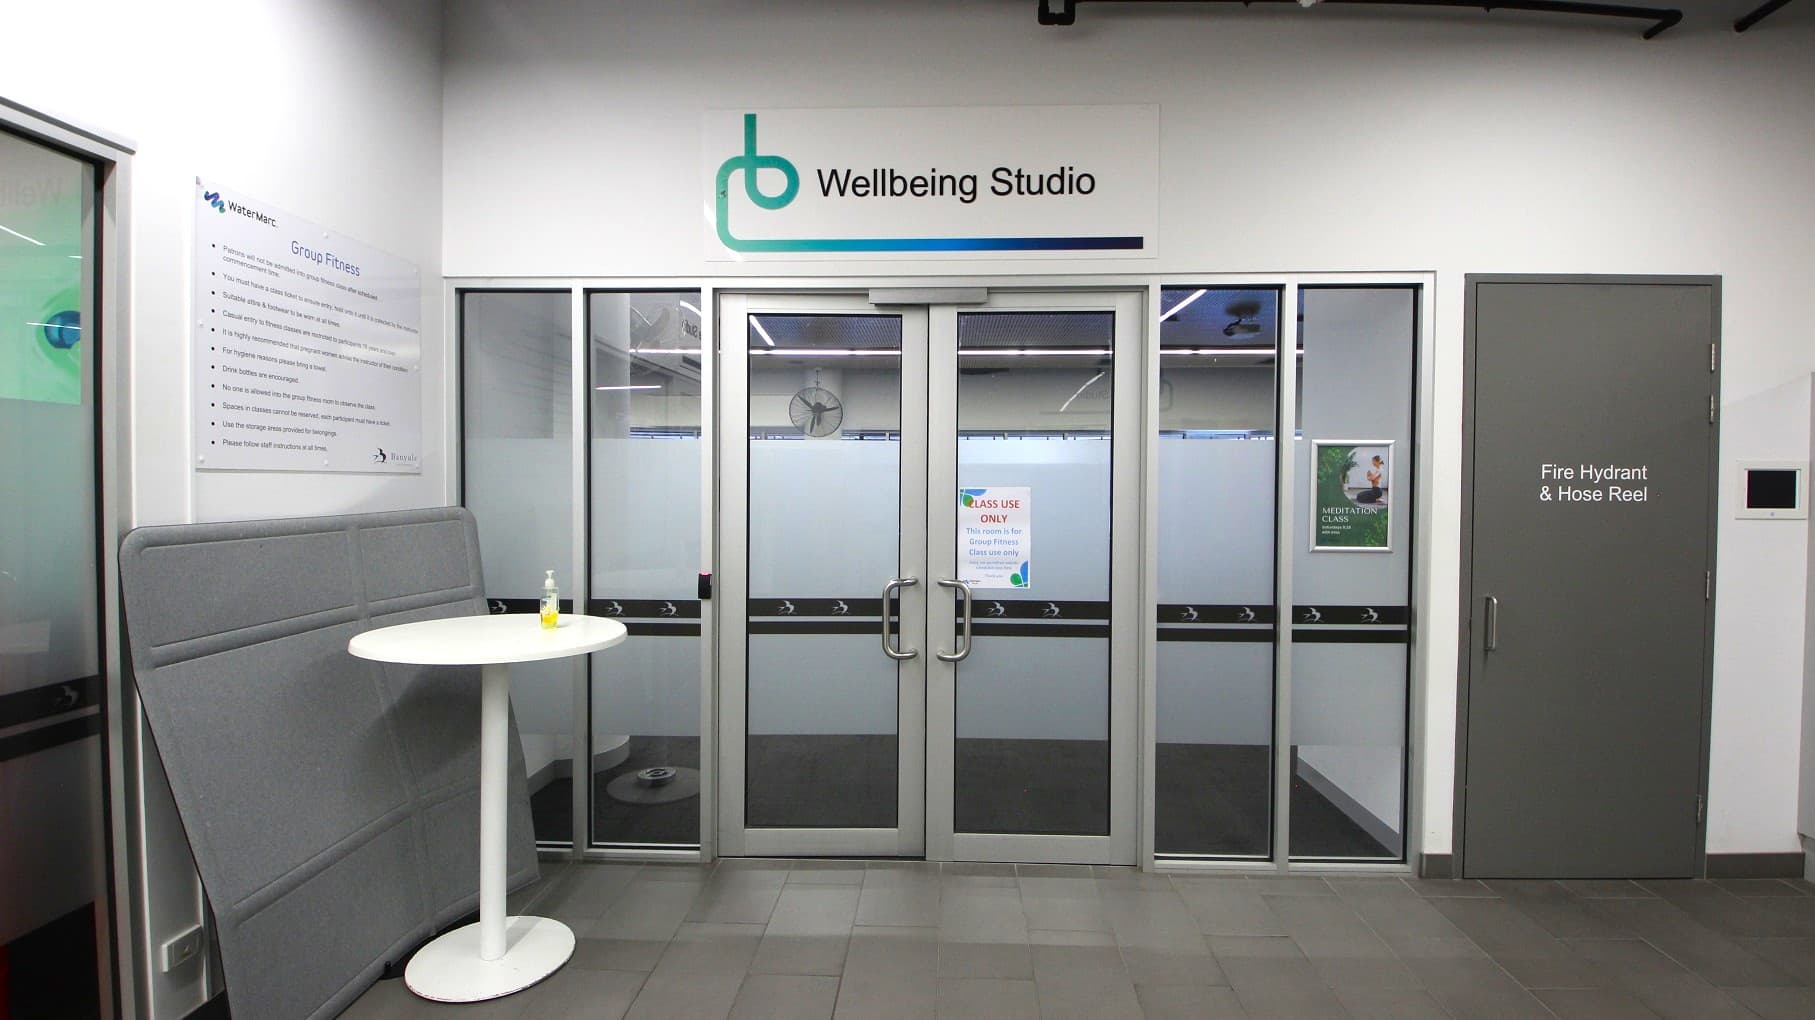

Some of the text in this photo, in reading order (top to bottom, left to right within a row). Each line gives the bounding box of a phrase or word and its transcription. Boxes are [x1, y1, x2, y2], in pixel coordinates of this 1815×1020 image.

[817, 166, 1096, 204] Wellbeing Studio
[228, 200, 276, 228] WaterMarc
[222, 256, 267, 274] commencement
[224, 245, 245, 257] Patrons
[274, 263, 296, 274] admitted
[306, 273, 320, 283] group
[320, 276, 335, 287] fitness
[291, 241, 360, 277] Group Fitness
[222, 273, 235, 282] You
[235, 277, 250, 287] must
[250, 280, 265, 291] have
[269, 287, 284, 296] class
[284, 291, 298, 300] ticket
[222, 291, 246, 304] Suitable
[247, 299, 261, 308] attire
[267, 303, 290, 314] footwear
[222, 309, 243, 321] Casual
[243, 316, 258, 325] entry
[265, 320, 283, 331] fitness
[283, 325, 302, 335] classes
[222, 328, 227, 336] It
[234, 331, 251, 342] highly
[251, 335, 289, 348] recommended
[289, 341, 300, 350] that
[222, 346, 233, 354] For
[233, 349, 256, 360] hygiene
[256, 354, 278, 363] reasons
[278, 359, 296, 367] please
[296, 361, 309, 370] bring
[222, 365, 238, 374] Drink
[238, 367, 258, 377] bottles
[222, 383, 232, 391] No
[250, 387, 272, 397] allowed
[291, 394, 306, 402] group
[306, 395, 322, 404] fitness
[222, 401, 244, 412] Spaces
[251, 406, 272, 414] classes
[272, 408, 290, 416] cannot
[235, 421, 245, 429] the
[245, 423, 267, 432] storage
[267, 424, 282, 432] areas
[282, 426, 305, 434] provided
[222, 438, 243, 447] Please
[243, 439, 260, 447] follow
[273, 442, 302, 450] instructions
[1541, 463, 1647, 484] Fire Hydrant
[1539, 486, 1648, 502] & Hose Reel
[968, 499, 1020, 509] CLASS USE
[1322, 507, 1378, 515] MEDITATION
[980, 514, 1008, 524] ONLY
[1322, 515, 1349, 523] CLASS
[966, 527, 981, 535] This
[1003, 527, 1009, 535] is
[1011, 527, 1022, 535] for
[969, 538, 1019, 547] Group Fitness
[969, 548, 988, 557] Class
[1003, 548, 1019, 558] only
